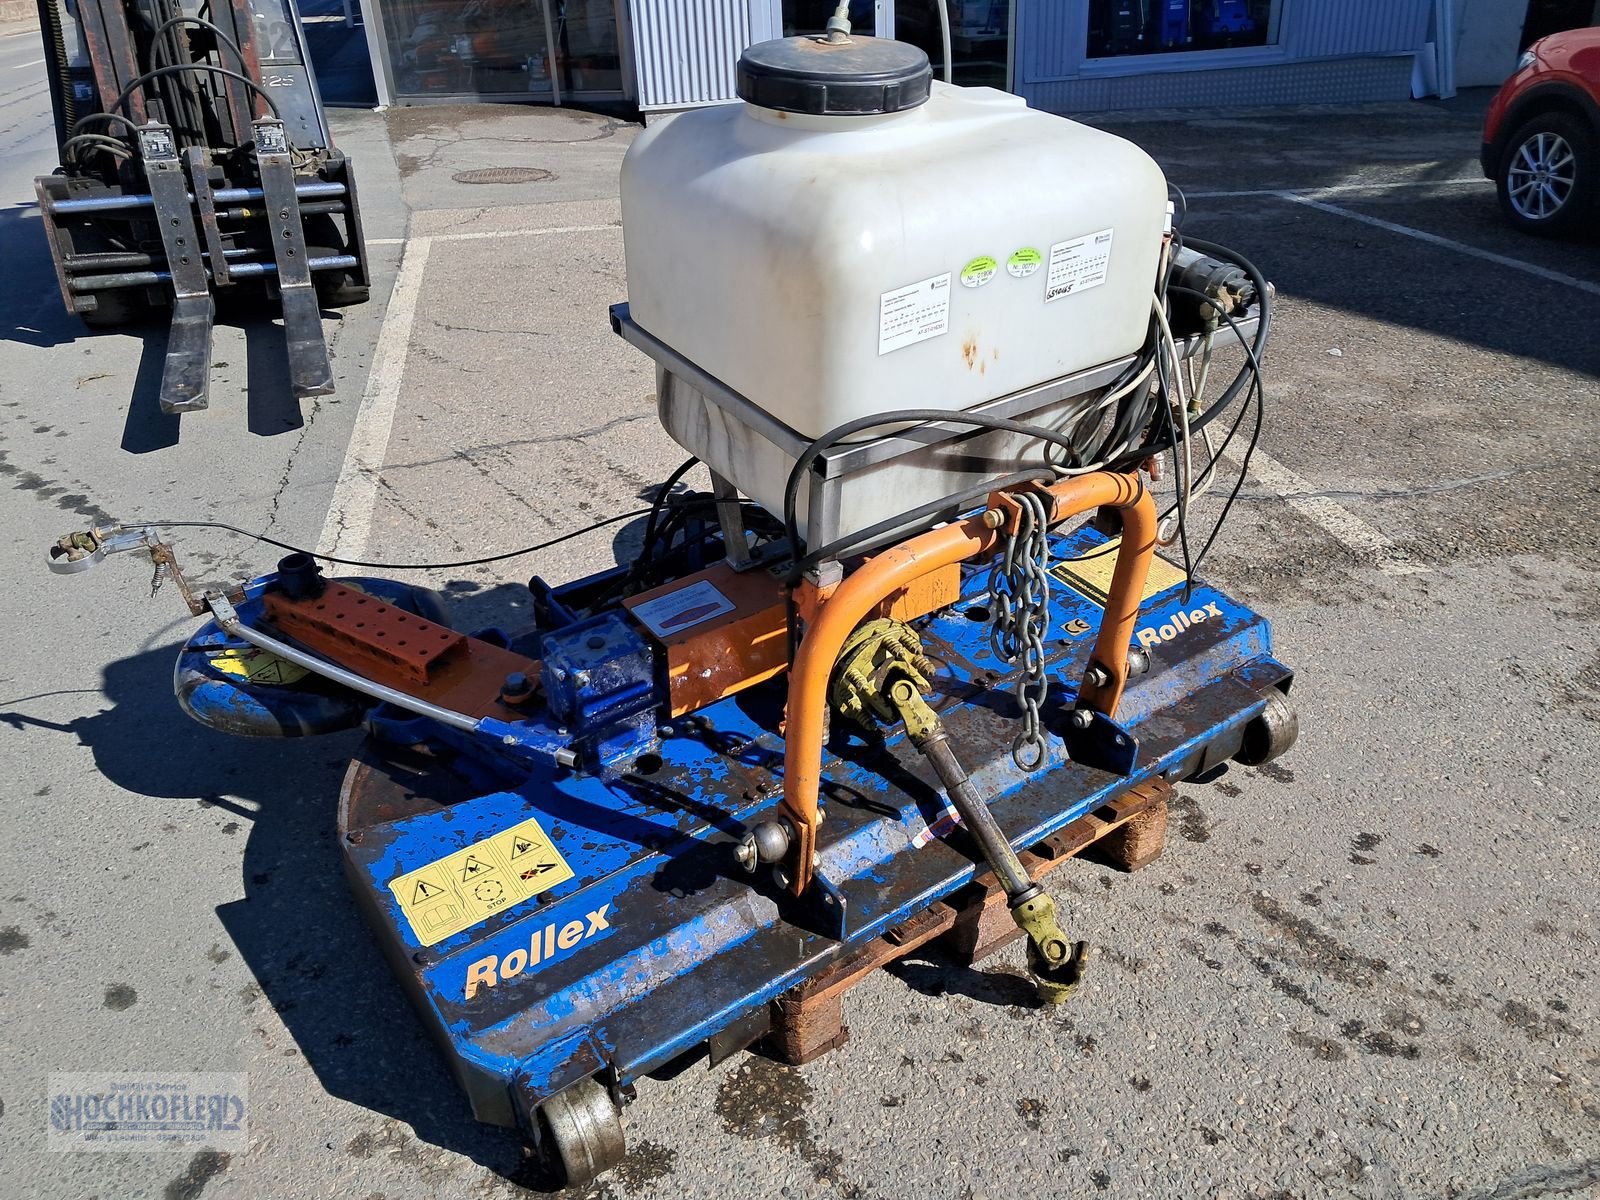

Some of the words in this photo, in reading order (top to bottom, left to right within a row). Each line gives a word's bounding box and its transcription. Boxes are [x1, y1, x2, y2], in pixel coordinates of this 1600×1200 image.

[1065, 619, 1089, 633] CE
[1136, 601, 1224, 647] Rollex
[486, 897, 507, 909] STOP
[465, 904, 610, 1000] Rollex
